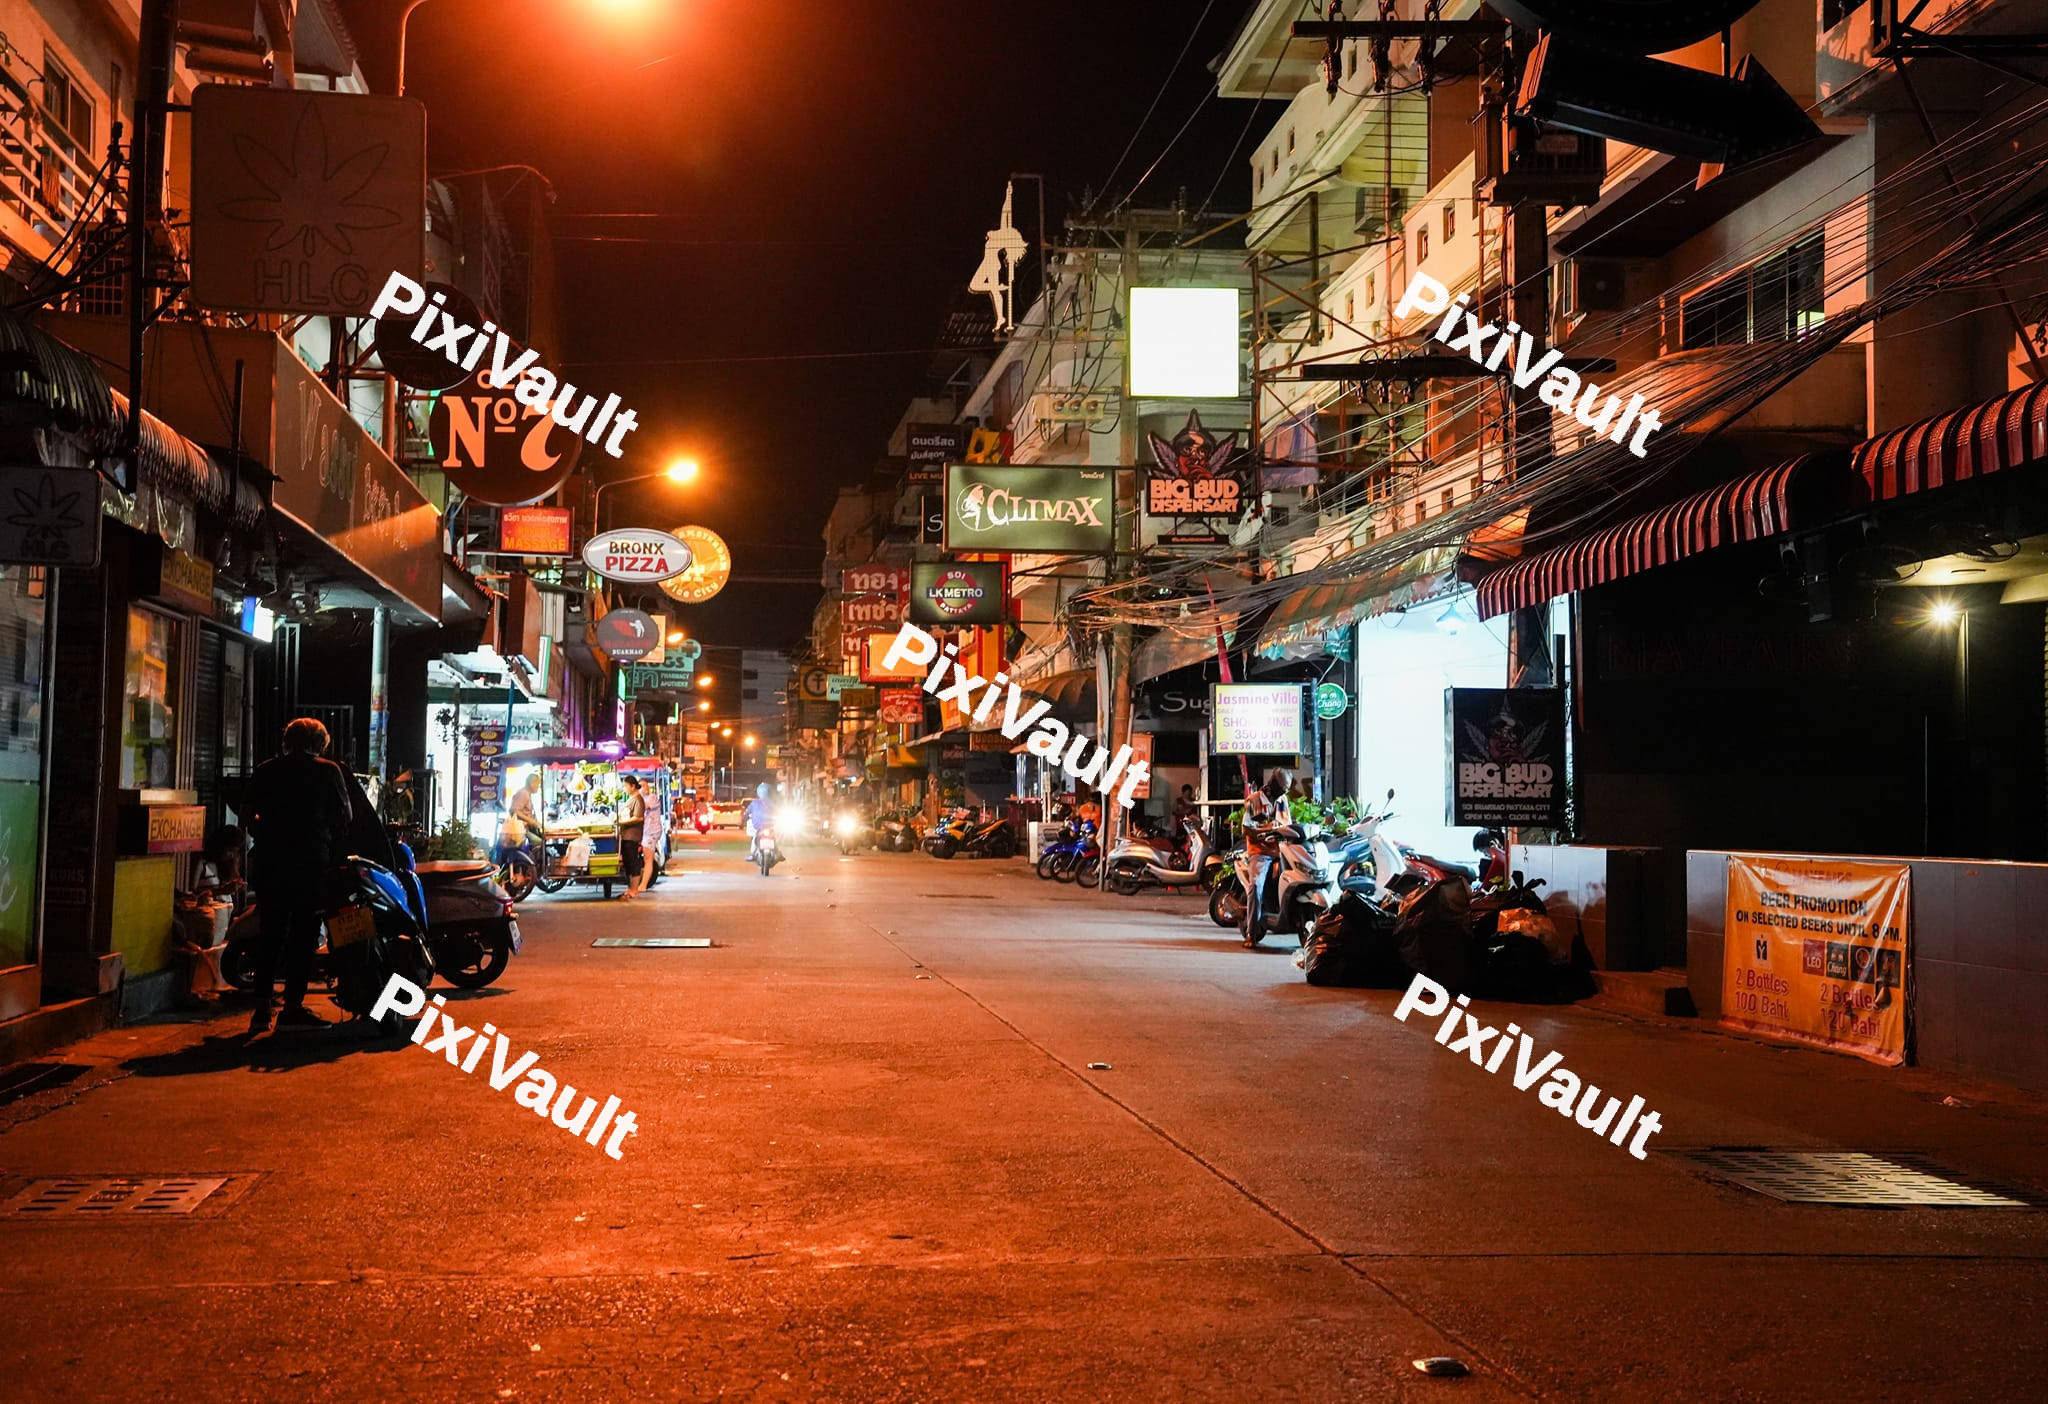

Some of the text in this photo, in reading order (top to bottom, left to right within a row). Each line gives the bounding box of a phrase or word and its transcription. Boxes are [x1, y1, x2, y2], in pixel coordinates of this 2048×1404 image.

[254, 257, 369, 308] HLC
[909, 472, 928, 480] LIVE
[1150, 479, 1239, 499] BIG BUD
[987, 488, 1104, 527] CLIMAX
[1150, 498, 1239, 513] DISPENSARY
[927, 514, 943, 532] S
[504, 537, 566, 551] MASSAGE
[609, 541, 664, 555] BRONX
[606, 556, 669, 573] PIZZA
[851, 573, 898, 590] ทอง
[947, 571, 966, 580] SOI
[694, 579, 719, 599] City
[944, 588, 983, 598] METRO
[940, 602, 973, 614] PATTAYA
[1160, 691, 1211, 715] Sug
[1217, 691, 1298, 705] Jasmine Villa
[1235, 729, 1257, 740] 350
[1232, 741, 1251, 750] 038
[1256, 741, 1274, 750] 488
[1459, 762, 1553, 786] BIG BUD
[1459, 783, 1553, 798] DISPENSARY
[151, 818, 201, 840] EXCHANGE
[1760, 891, 1867, 917] BEER PROMOTION
[1736, 910, 1749, 922] ON
[1752, 912, 1799, 929] SELECTED
[1801, 919, 1833, 934] BEERS
[1837, 921, 1868, 938] UNTIL
[1872, 923, 1879, 937] 8
[1806, 957, 1821, 969] LEO
[1827, 961, 1846, 975] Chang
[1736, 968, 1789, 995] 2 Bottles
[1820, 983, 1828, 1003] 2
[1736, 992, 1789, 1019] 100 Baht
[1821, 1009, 1846, 1033] 120
